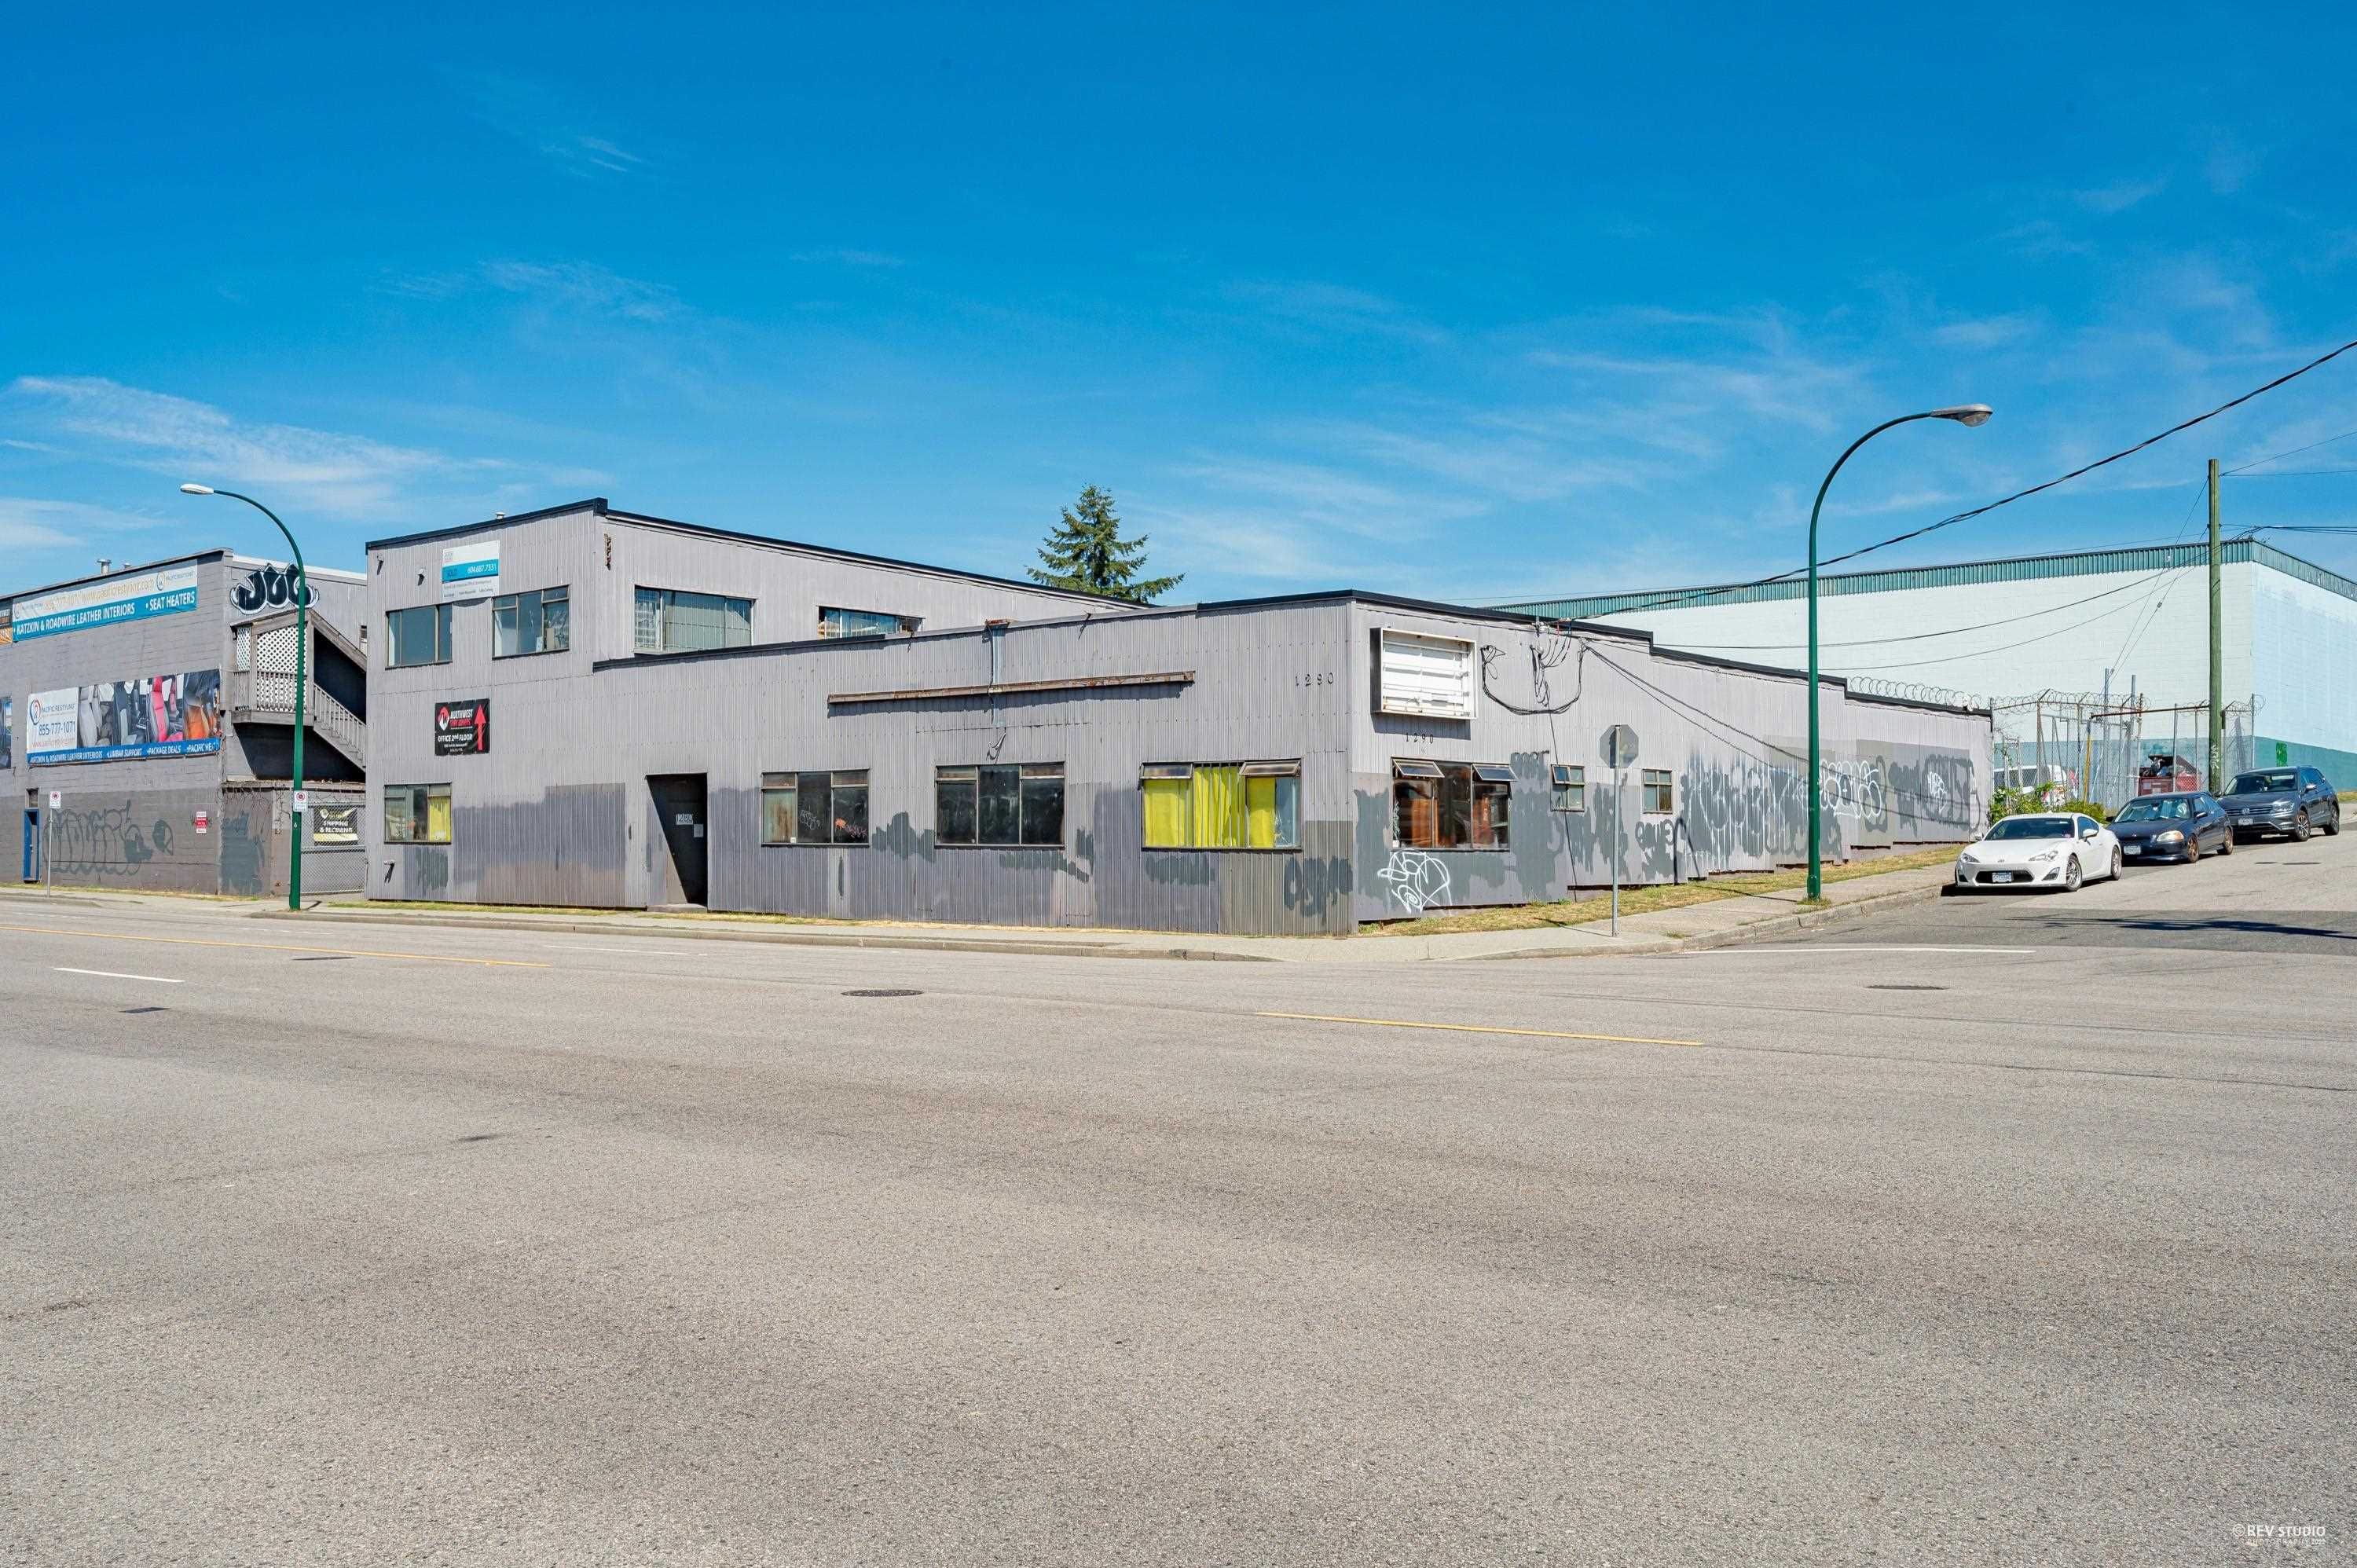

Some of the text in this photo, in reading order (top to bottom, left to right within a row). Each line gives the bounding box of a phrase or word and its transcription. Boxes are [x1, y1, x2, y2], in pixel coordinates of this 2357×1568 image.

[17, 621, 39, 635] KATZKIN
[41, 620, 45, 631] &
[46, 614, 75, 629] ROADWIRE
[76, 610, 101, 625] LEATHER
[103, 603, 135, 619] INTERIORS
[149, 596, 165, 610] SEAT
[167, 592, 195, 606] HEATERS
[38, 721, 75, 735] 855-777-1071
[1406, 732, 1434, 744] 1290
